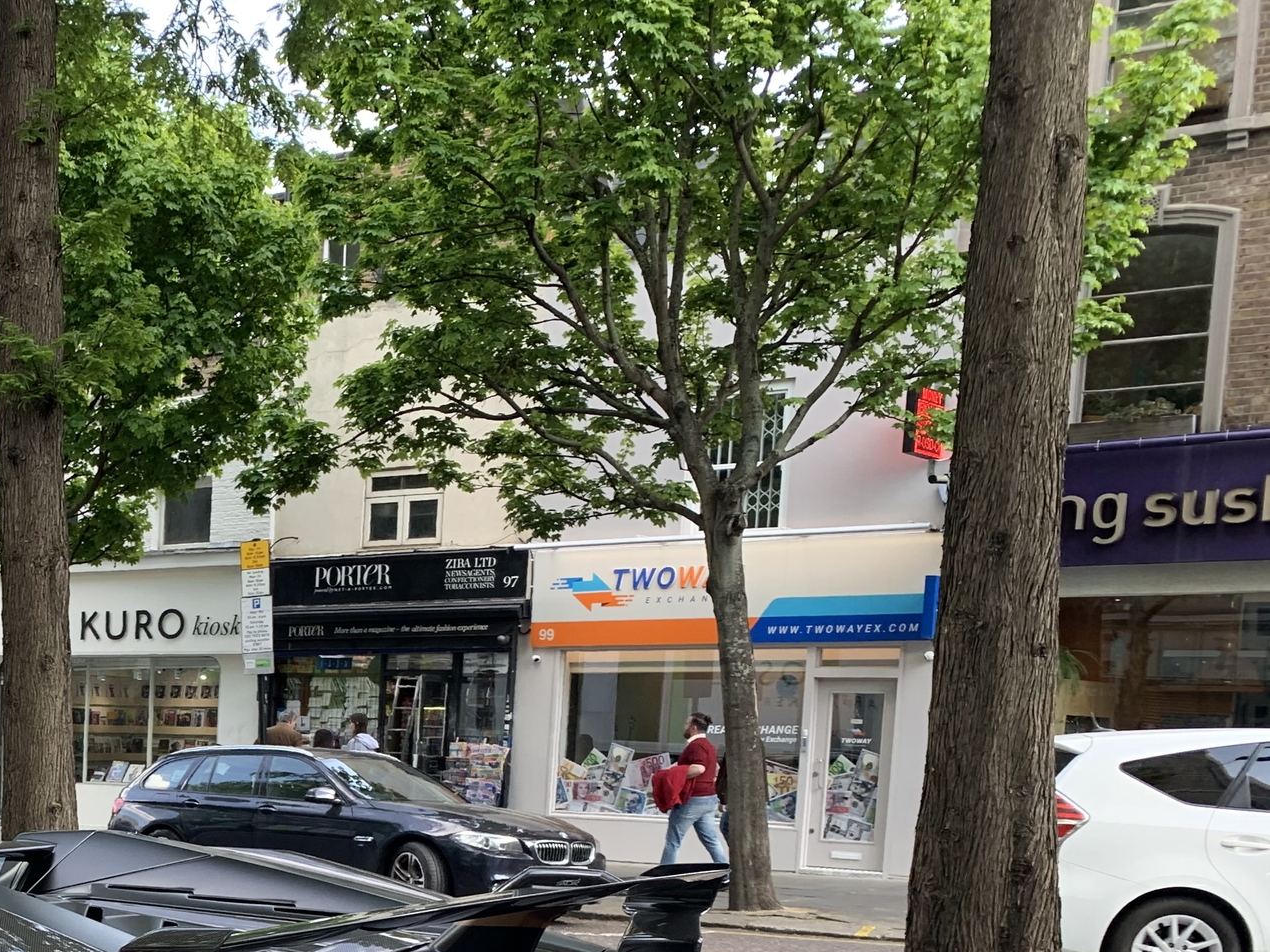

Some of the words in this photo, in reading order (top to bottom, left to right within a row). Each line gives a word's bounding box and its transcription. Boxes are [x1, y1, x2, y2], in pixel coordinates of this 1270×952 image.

[474, 557, 497, 568] LTD
[503, 575, 519, 588] 97
[613, 565, 709, 591] TWOW
[80, 608, 186, 641] KURO
[192, 614, 241, 636] kiosk
[767, 623, 920, 635] WWW.TWOWAYEX.COM
[538, 628, 555, 641] 99
[759, 725, 799, 735] HANGE
